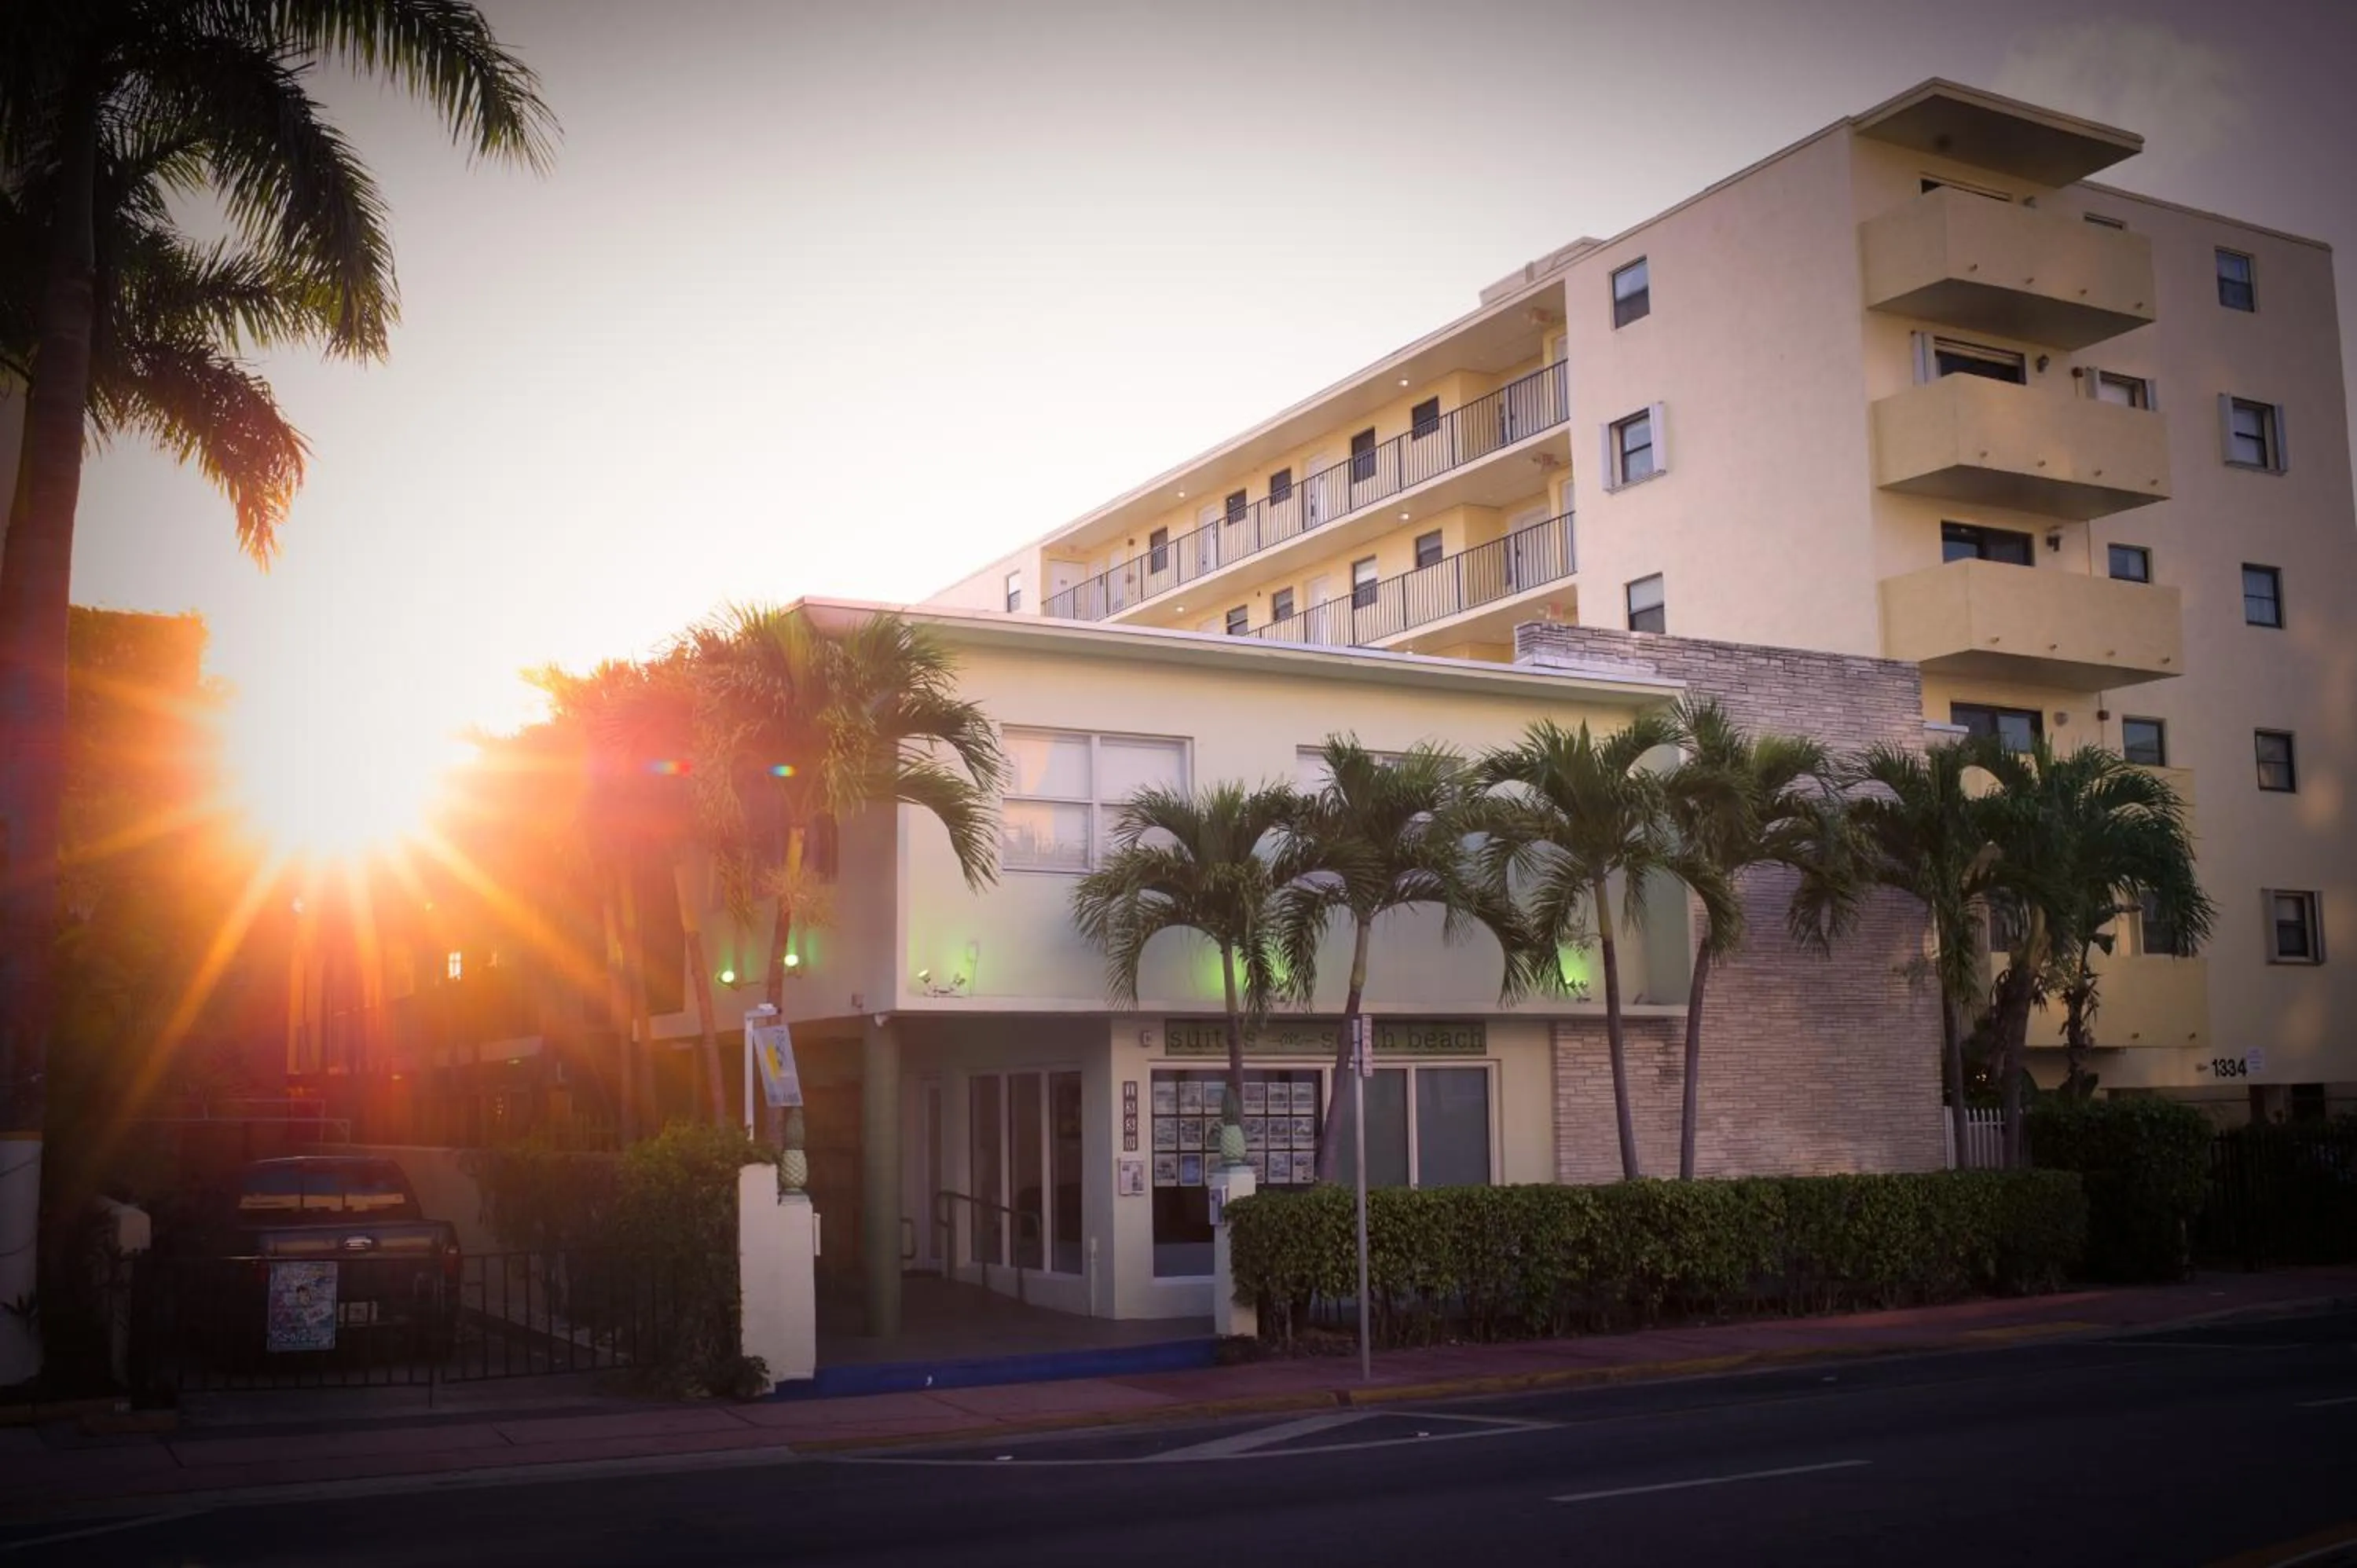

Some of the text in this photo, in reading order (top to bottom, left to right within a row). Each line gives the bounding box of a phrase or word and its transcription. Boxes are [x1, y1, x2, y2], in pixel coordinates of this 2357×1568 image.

[1169, 1028, 1257, 1049] suits
[1407, 1024, 1484, 1049] beach
[2212, 1057, 2248, 1077] 1334
